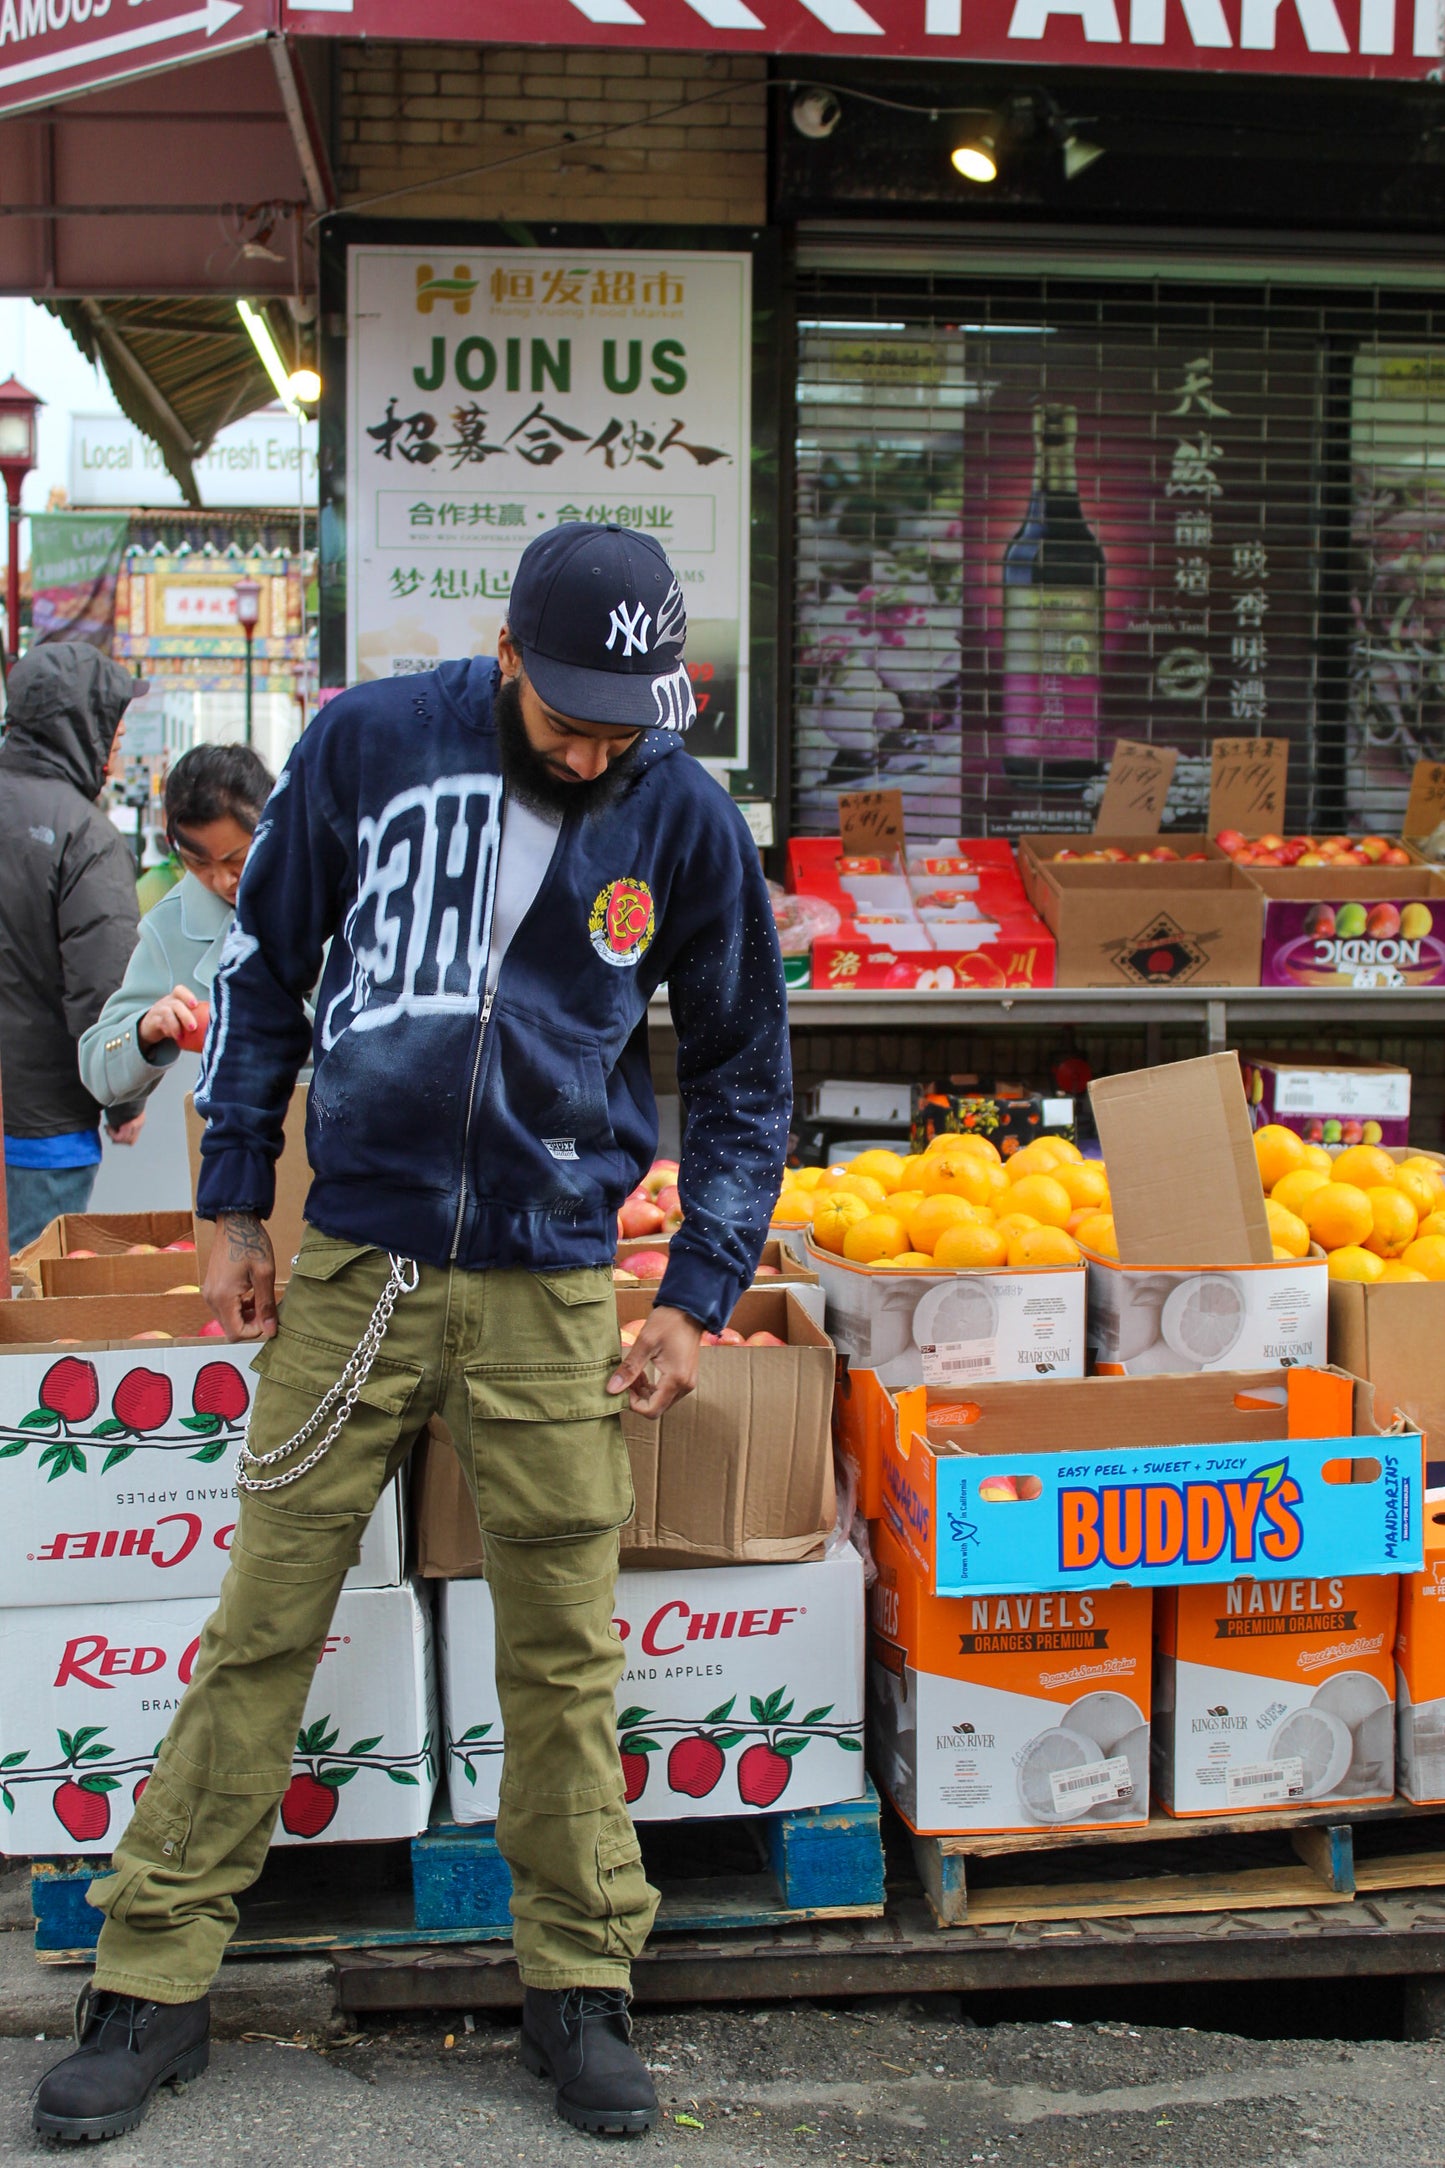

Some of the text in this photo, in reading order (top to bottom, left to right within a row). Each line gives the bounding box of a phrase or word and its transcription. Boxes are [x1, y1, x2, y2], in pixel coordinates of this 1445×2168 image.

[489, 267, 687, 306] 恒发超市
[413, 335, 688, 395] JOIN US
[366, 398, 733, 470] 招募合伙人
[82, 437, 133, 470] Local
[605, 600, 652, 657] NY
[1314, 939, 1421, 964] NORDIC
[1057, 1466, 1090, 1478] EASY
[1094, 1464, 1127, 1477] PEEL
[1143, 1460, 1191, 1474] SWEET
[1206, 1458, 1247, 1472] JUICY
[117, 1490, 178, 1505] APPLES
[959, 1479, 968, 1511] California
[1384, 1455, 1399, 1558] MANDARINS
[960, 1542, 969, 1579] Grown with
[972, 1596, 1095, 1631] NAVELS
[1226, 1579, 1345, 1615] NAVELS
[1228, 1614, 1345, 1636] PREMIUM ORANGES
[974, 1632, 1095, 1652] ORANGES PREMIUM
[53, 1634, 168, 1689] RED
[664, 1663, 724, 1680] APPLES
[1191, 1716, 1248, 1733] KINGS RIVER
[936, 1734, 995, 1750] KINGS RIVER
